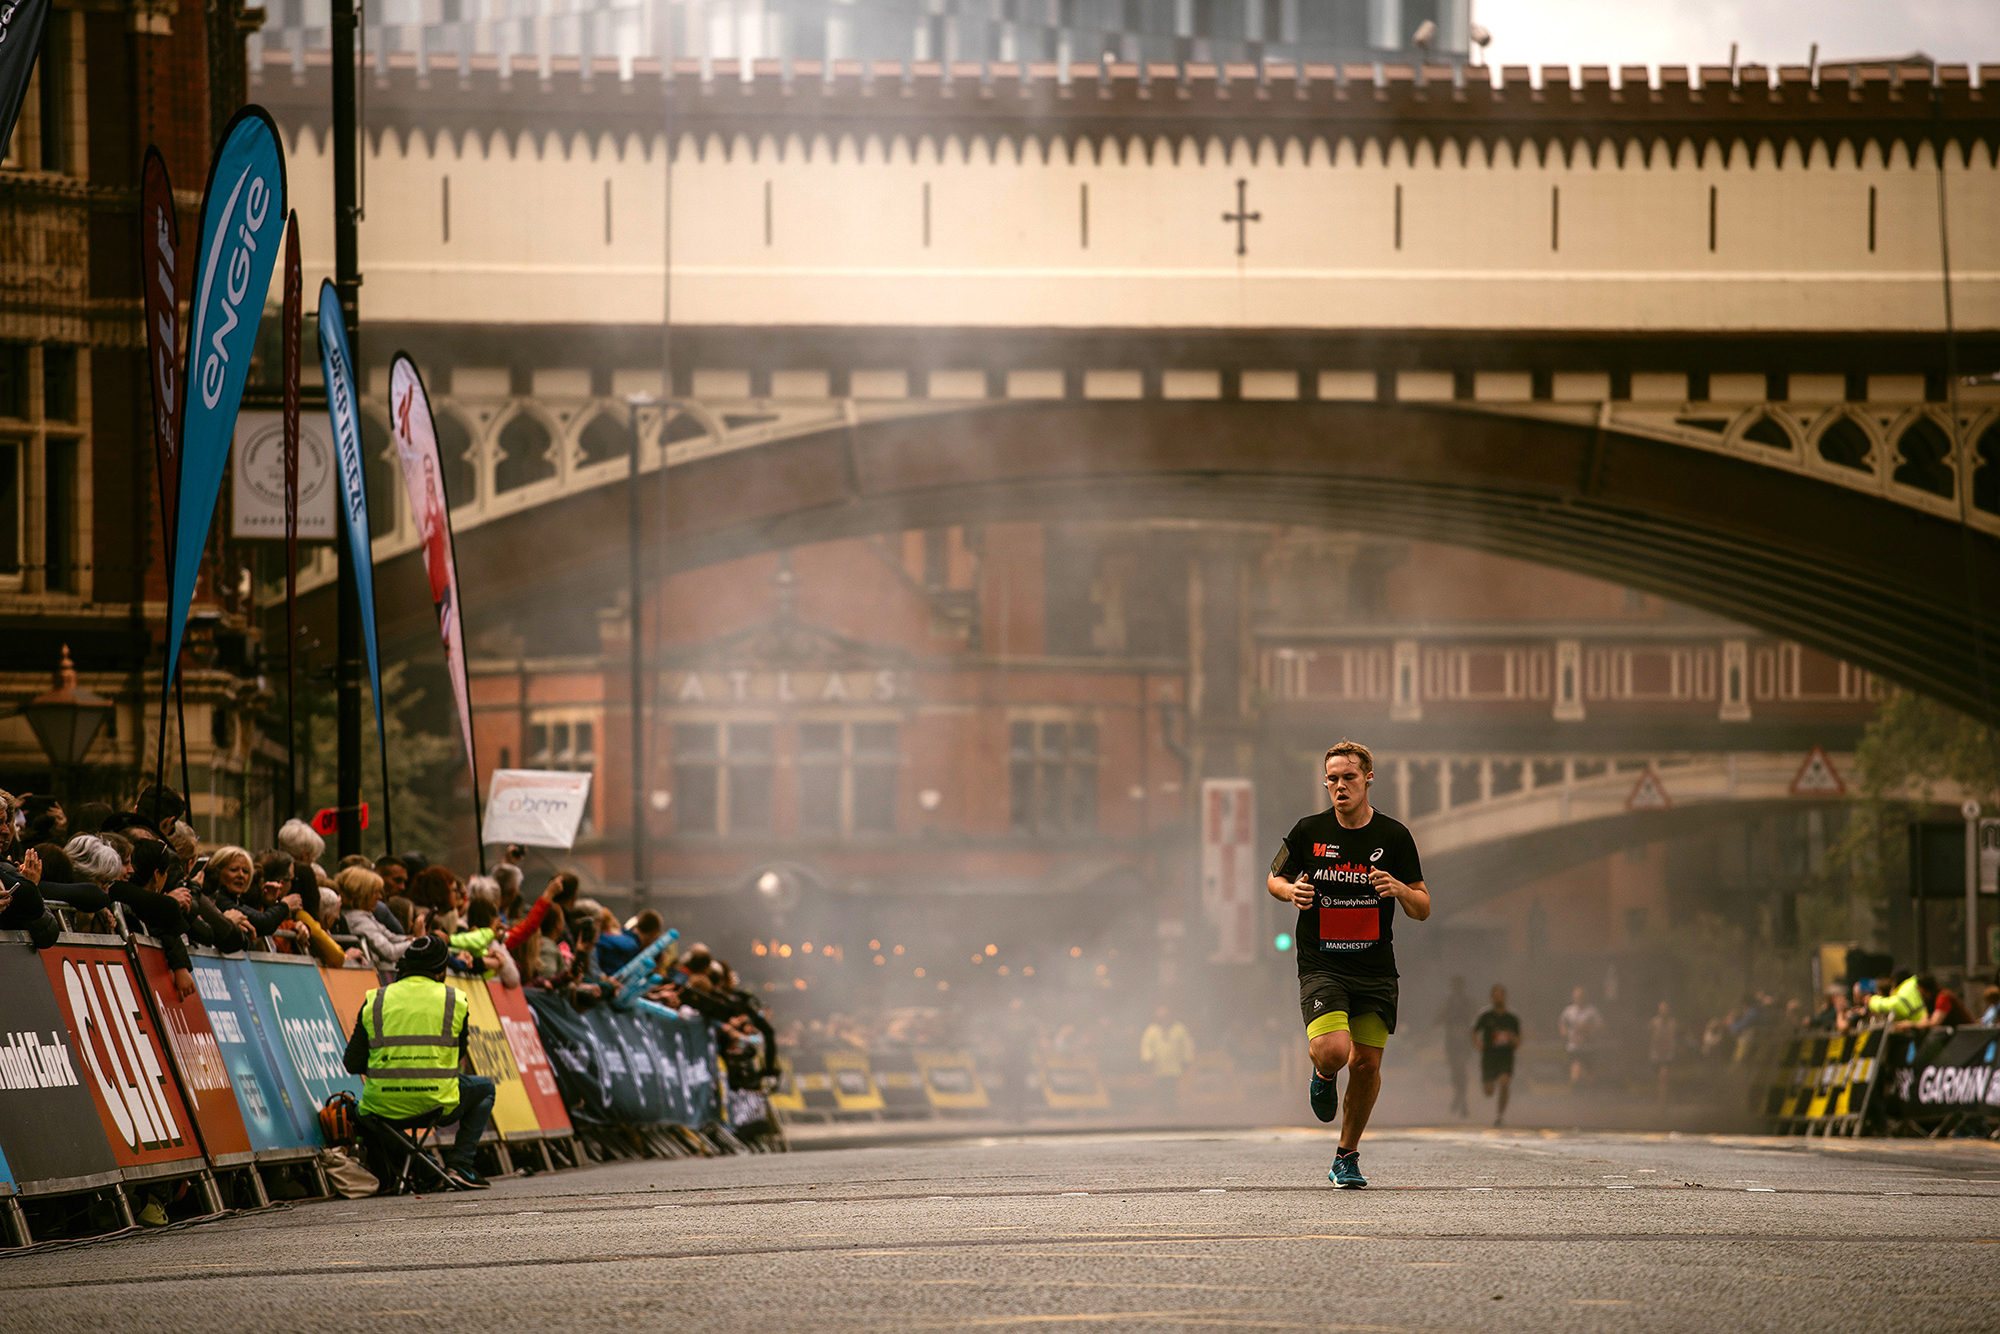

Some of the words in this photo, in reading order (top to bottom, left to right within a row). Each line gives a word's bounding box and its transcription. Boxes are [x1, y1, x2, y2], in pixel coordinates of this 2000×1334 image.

[157, 203, 175, 416] CLIF
[340, 416, 363, 522] FREEZE
[678, 669, 896, 701] ATLAS
[1313, 868, 1374, 885] MANCHEST
[1333, 898, 1378, 907] Simplyhealth
[23, 1031, 79, 1088] Clark
[62, 956, 184, 1154] CLIF
[269, 981, 352, 1113] Compeed
[1918, 1065, 1991, 1105] GARMIN
